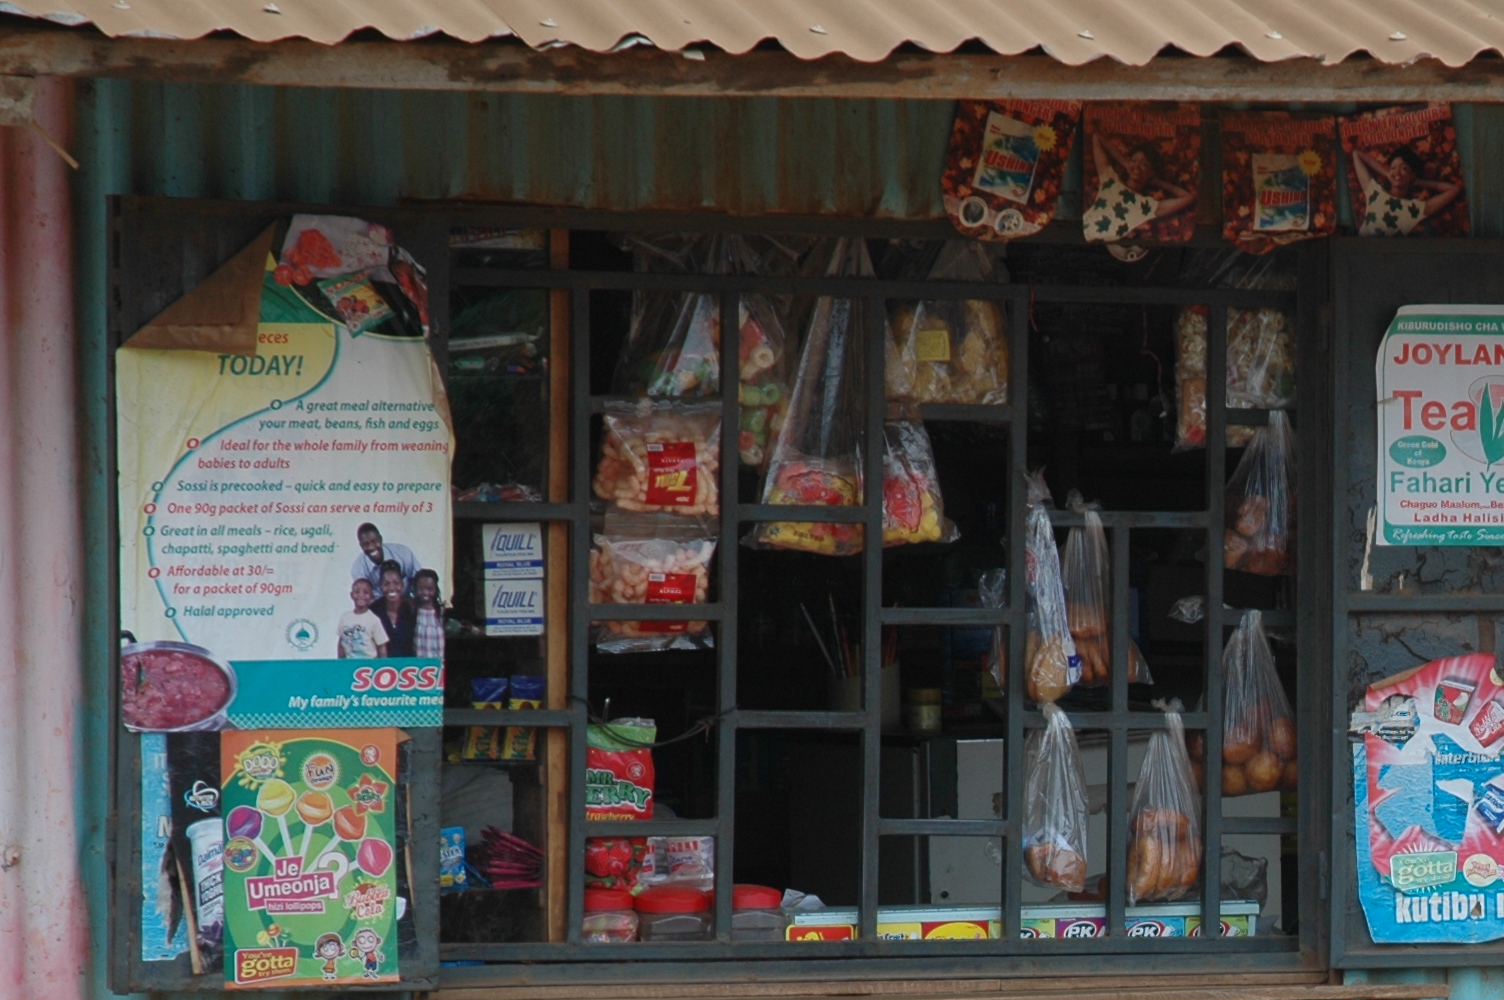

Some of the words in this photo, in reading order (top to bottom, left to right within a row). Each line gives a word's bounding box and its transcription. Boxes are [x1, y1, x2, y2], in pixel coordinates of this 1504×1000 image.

[1398, 322, 1472, 330] KIBURUDISHO
[217, 355, 303, 376] TODAY!
[296, 401, 304, 411] A
[306, 402, 338, 412] great
[340, 401, 369, 411] meal
[371, 401, 434, 411] alternative
[1393, 390, 1475, 430] Tea
[259, 420, 285, 431] your
[291, 420, 322, 430] meat,
[325, 419, 361, 429] beans,
[365, 418, 384, 429] fish
[388, 419, 410, 429] and
[412, 420, 439, 432] eggs
[198, 458, 235, 469] babies
[239, 460, 250, 468] to
[253, 458, 290, 469] adults
[1391, 472, 1470, 493] Fahari
[1414, 513, 1457, 522] Ladha
[496, 534, 534, 550] QUILL
[167, 565, 229, 576] Affordable
[233, 566, 245, 576] at
[247, 565, 274, 576] 30/=
[496, 590, 534, 608] QUILL
[184, 606, 214, 616] Halal
[216, 606, 274, 618] approved
[288, 696, 309, 708] My
[311, 696, 359, 708] family's
[361, 694, 417, 707] favourite
[587, 770, 618, 785] MR.
[277, 861, 299, 876] Je
[1398, 862, 1451, 884] gotta
[250, 876, 330, 899] Umeonja
[286, 901, 322, 911] lollipops
[1396, 892, 1486, 923] kutibu
[241, 957, 293, 978] gotta
